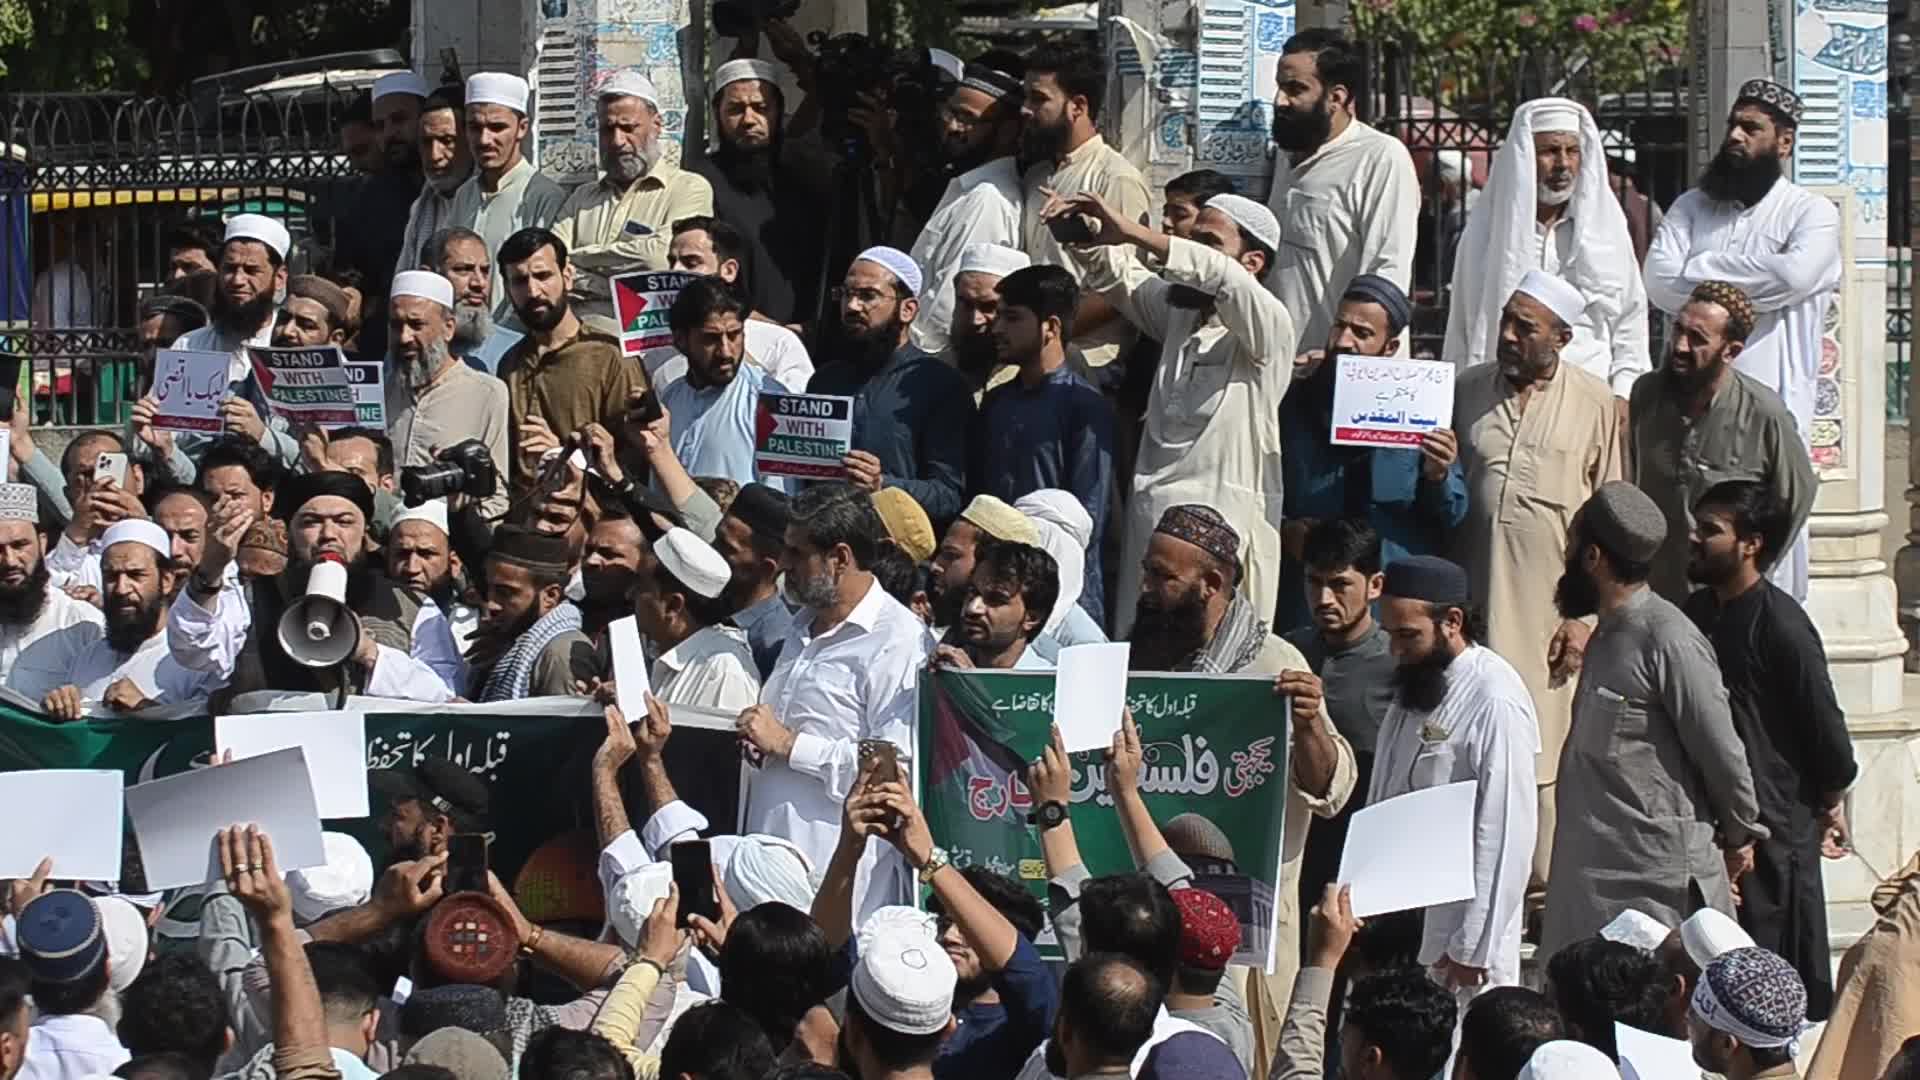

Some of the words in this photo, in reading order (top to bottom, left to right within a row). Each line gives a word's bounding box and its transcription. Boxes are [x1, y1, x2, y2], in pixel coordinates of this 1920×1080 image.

[647, 275, 689, 290] STAN
[271, 351, 325, 367] STAND
[282, 370, 324, 386] WITH
[272, 387, 351, 402] PALESTINE
[779, 398, 834, 416] STAND
[1350, 408, 1407, 425] المقدس
[786, 418, 825, 437] WITH
[767, 437, 847, 457] PALESTINE
[1126, 692, 1148, 714] تحف
[1071, 733, 1220, 808] فلسین
[967, 769, 1034, 822] ارچ
